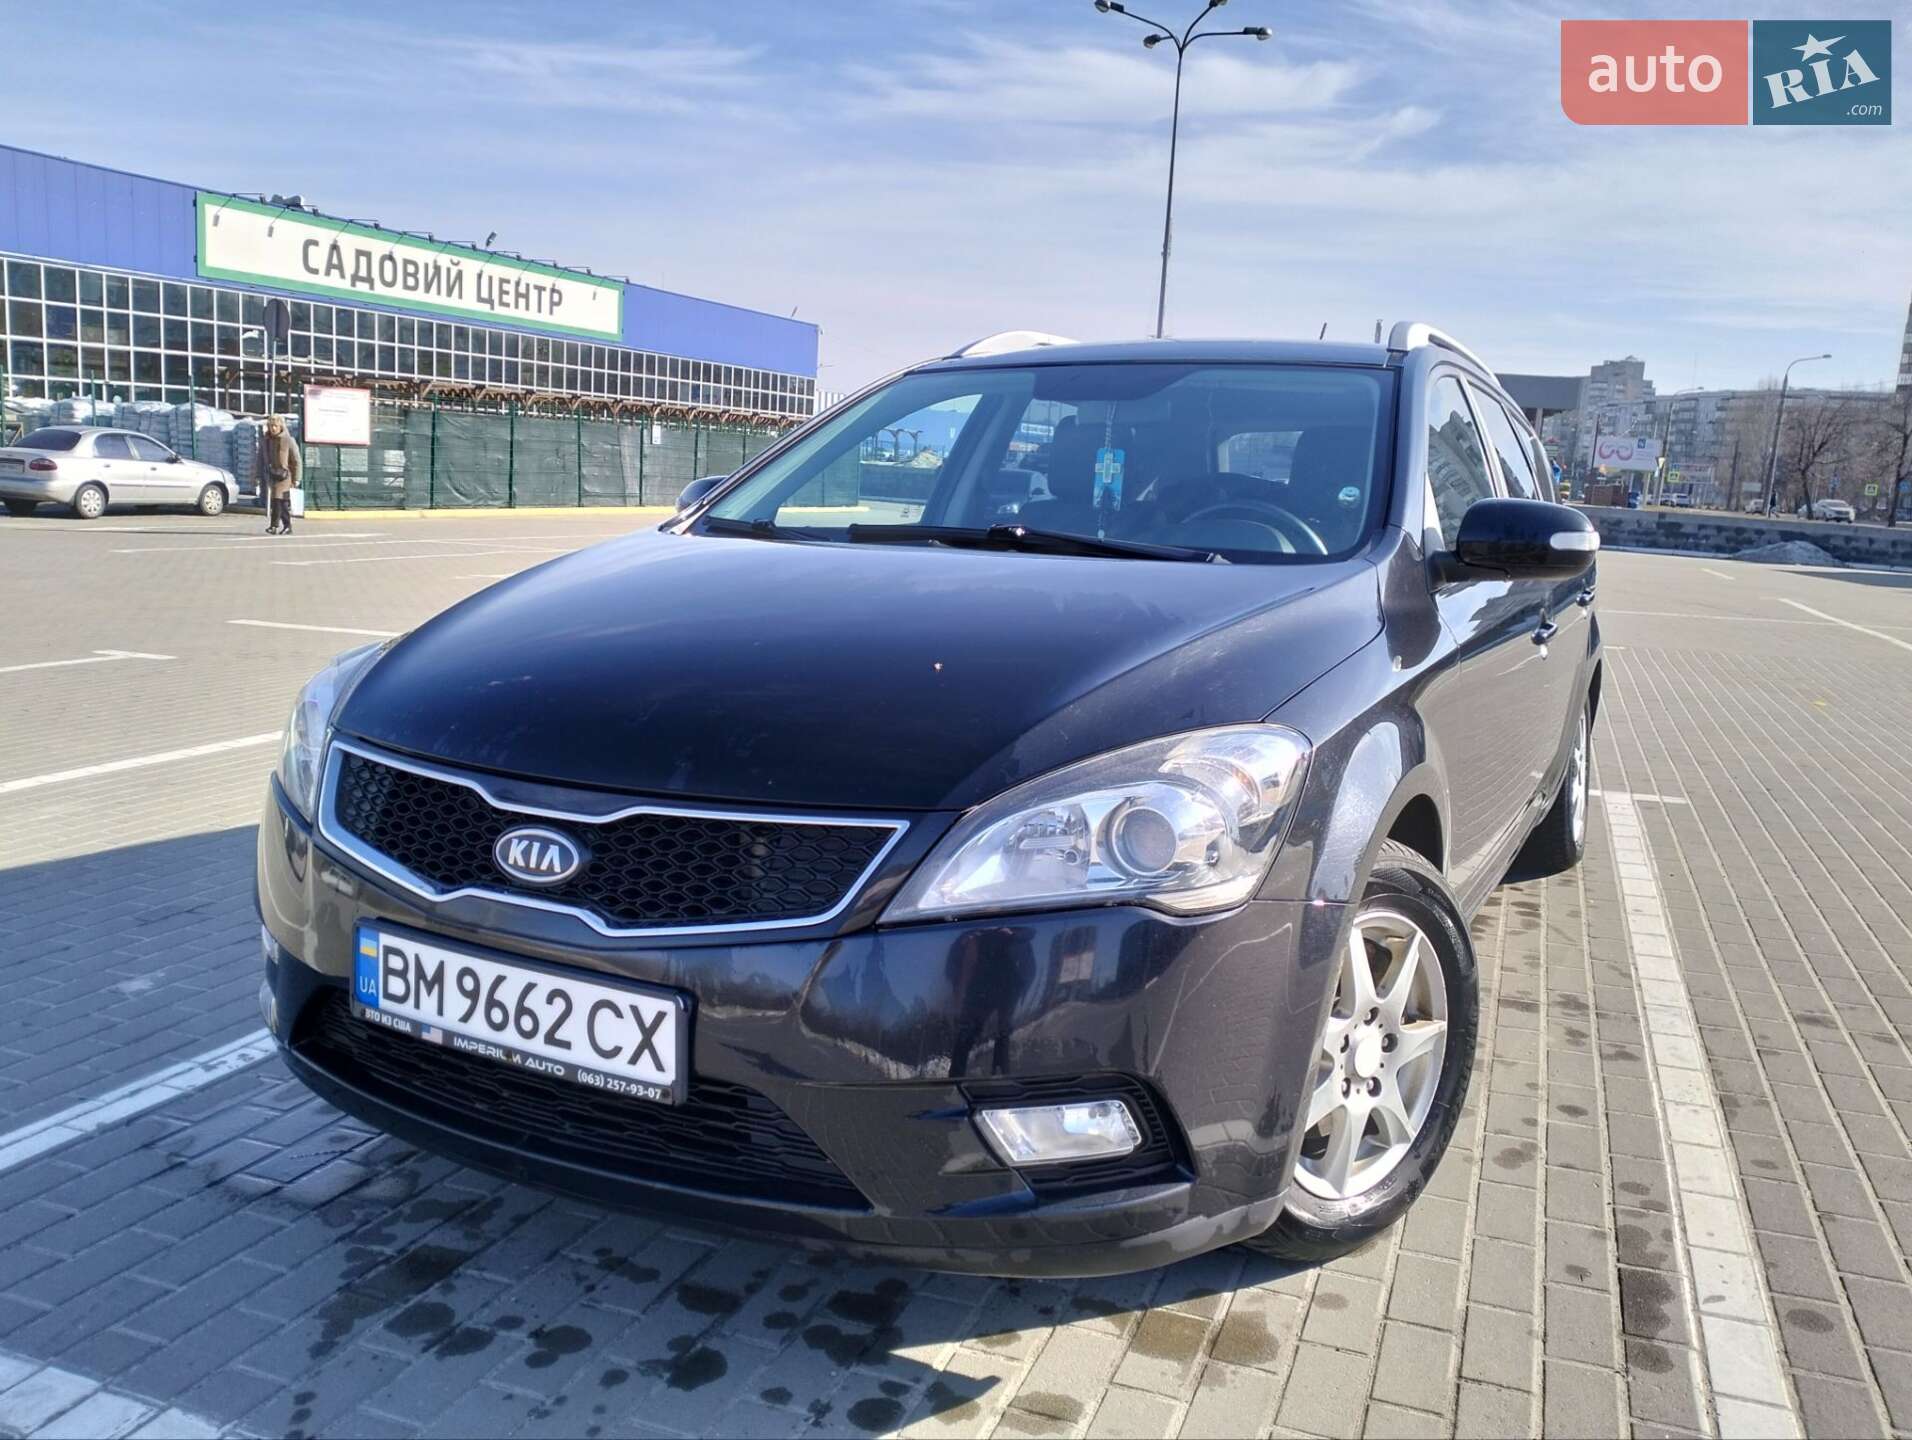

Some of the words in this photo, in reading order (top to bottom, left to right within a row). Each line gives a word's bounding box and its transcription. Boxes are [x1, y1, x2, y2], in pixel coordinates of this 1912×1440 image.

[302, 239, 463, 300] САДОВИЙ
[476, 270, 563, 316] ЦЕНТР
[508, 838, 561, 872] KIA
[359, 976, 377, 997] UA
[382, 944, 445, 1017] BM
[456, 966, 573, 1050] 9662
[587, 998, 667, 1073] CX
[524, 1059, 565, 1076] AUTO
[577, 1068, 605, 1087] (063)
